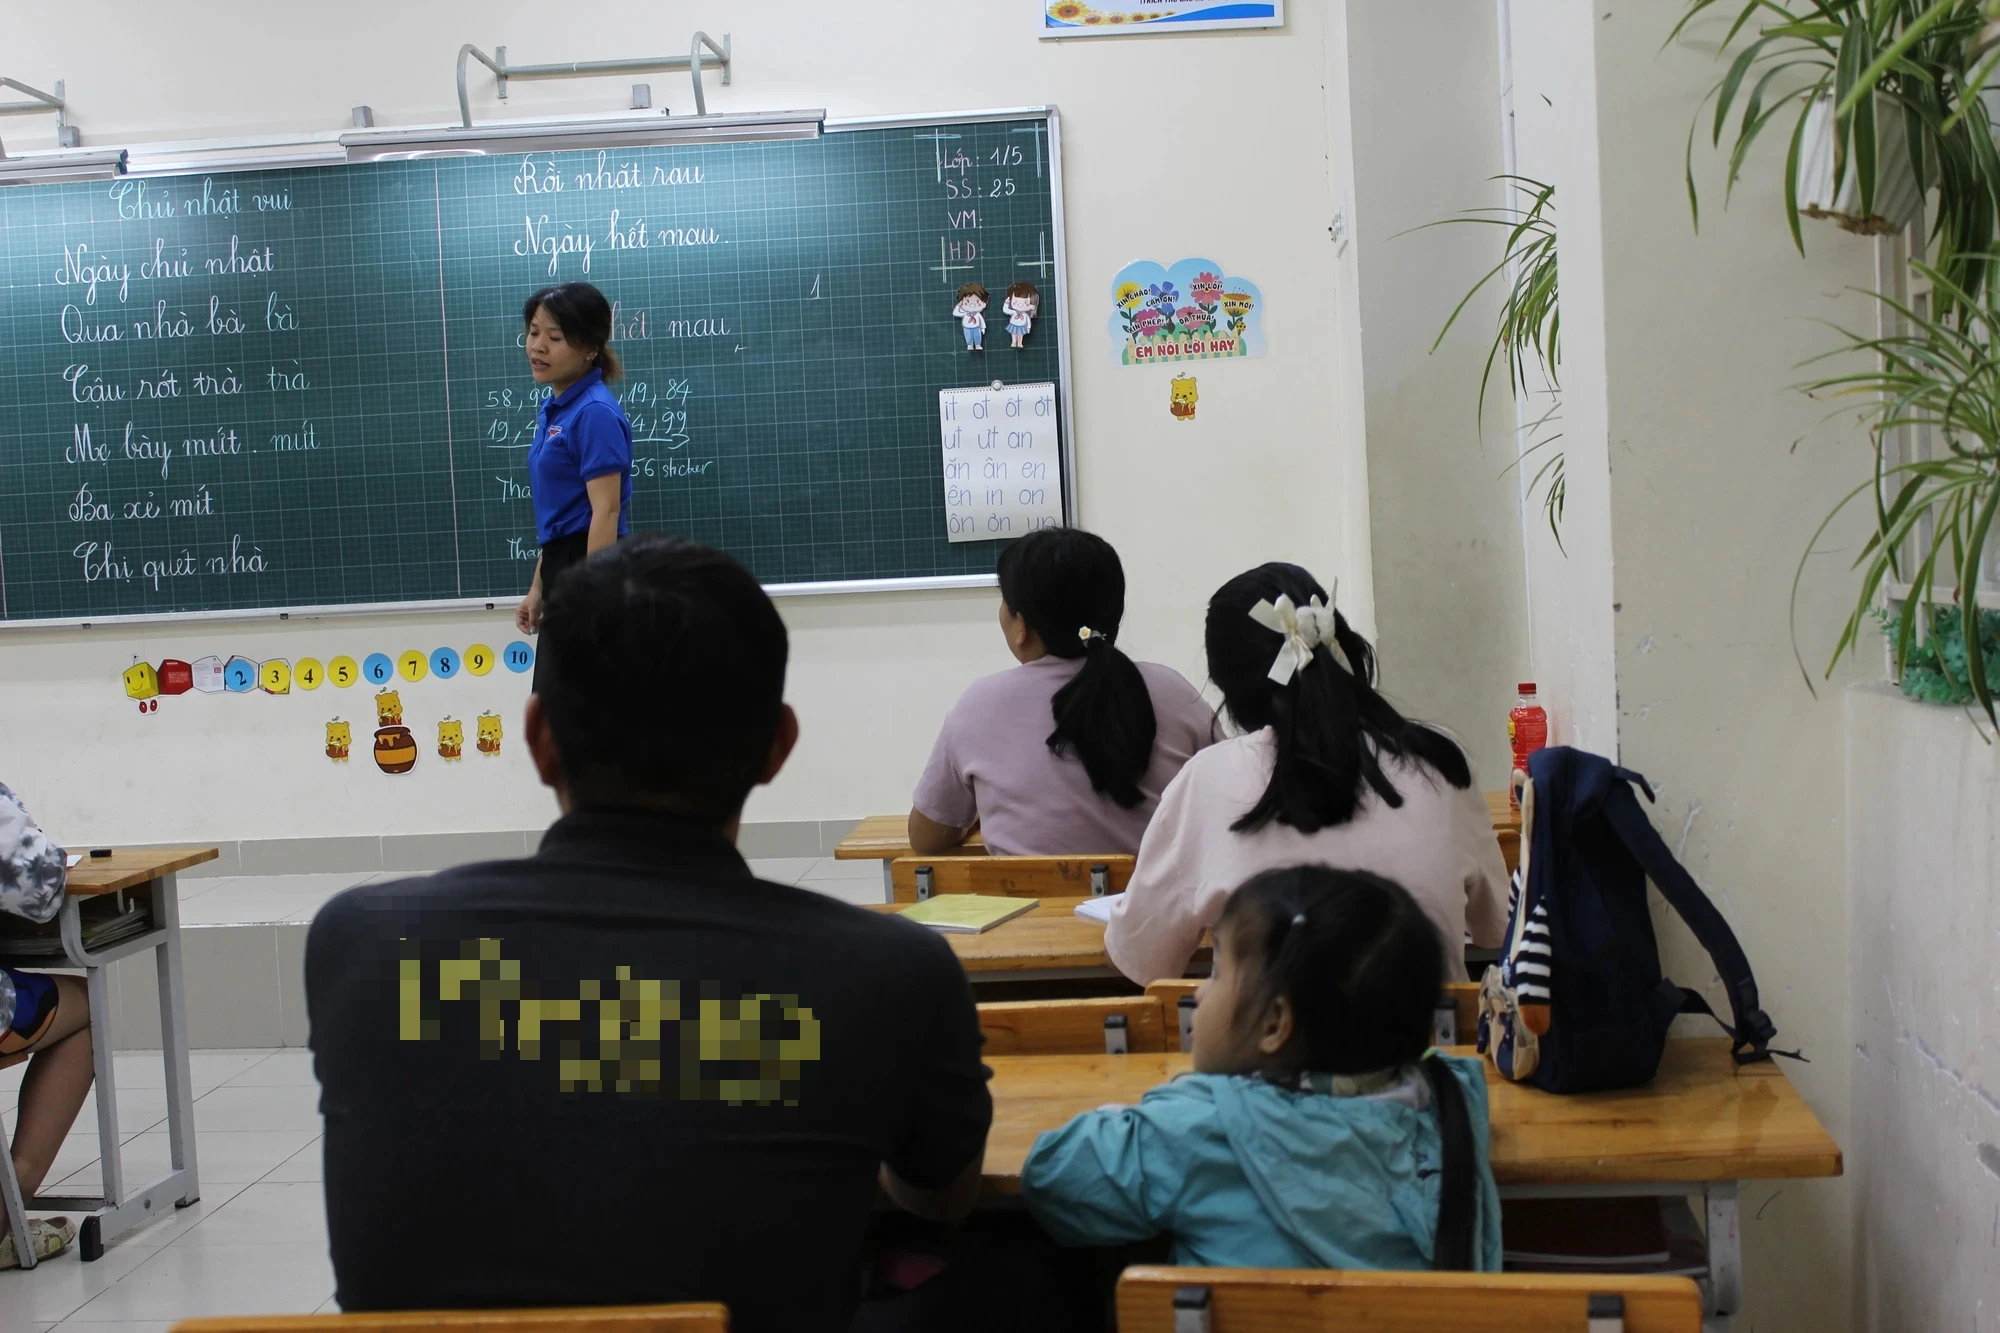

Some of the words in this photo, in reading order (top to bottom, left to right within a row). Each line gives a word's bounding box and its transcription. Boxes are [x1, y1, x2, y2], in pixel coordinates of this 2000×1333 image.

[990, 145, 1023, 166] 1/5
[513, 153, 564, 195] Rồi
[575, 150, 642, 194] nhặt
[651, 165, 705, 186] rau
[109, 180, 175, 220] Chủ
[184, 177, 242, 220] nhật
[252, 188, 292, 212] vui
[946, 178, 982, 200] SS:
[990, 178, 1016, 198] 25
[947, 209, 982, 229] VM:
[514, 215, 596, 277] Ngày
[604, 209, 649, 250] hết
[55, 243, 131, 306] Ngày
[141, 238, 193, 279] chủ
[205, 234, 274, 278] nhật
[1192, 283, 1205, 291] XIN
[1116, 297, 1129, 309] XIN
[61, 304, 124, 343] Qua
[134, 300, 194, 339] nhà
[205, 295, 245, 335] bà
[264, 291, 299, 332] bà
[668, 316, 731, 338] mau
[1136, 346, 1153, 358] EM
[1157, 341, 1179, 356] NÓI
[1184, 340, 1205, 353] LỜI
[1210, 340, 1235, 352] HAY
[62, 364, 125, 409] Cậu
[136, 369, 181, 400] rót
[193, 367, 242, 396] trà
[266, 359, 310, 391] trà
[666, 378, 692, 406] 84
[944, 395, 958, 420] it
[972, 394, 990, 419] ot
[1005, 394, 1022, 417] ôt
[662, 410, 687, 434] 99
[944, 426, 962, 449] ut
[1007, 431, 1033, 449] an
[65, 423, 111, 466] Mẹ
[120, 421, 172, 480] bày
[662, 457, 713, 478] sticker
[945, 457, 970, 480] ăn
[983, 457, 1007, 480] ân
[1021, 461, 1046, 480] en
[68, 482, 114, 521] Ba
[123, 491, 160, 519] xẻ
[170, 484, 214, 517] mít
[948, 484, 971, 506] ên
[986, 486, 1003, 506] in
[1019, 489, 1044, 506] on
[949, 513, 974, 534] ôn
[73, 541, 133, 583] Chị
[143, 548, 196, 591] quét
[206, 534, 268, 574] nhà
[235, 670, 247, 686] 2
[271, 670, 280, 683] 3
[303, 668, 314, 684] 4
[338, 666, 349, 682] 5
[373, 663, 384, 679] 6
[408, 660, 418, 676] 7
[440, 657, 451, 673] 8
[474, 654, 484, 670] 9
[511, 650, 528, 665] 10
